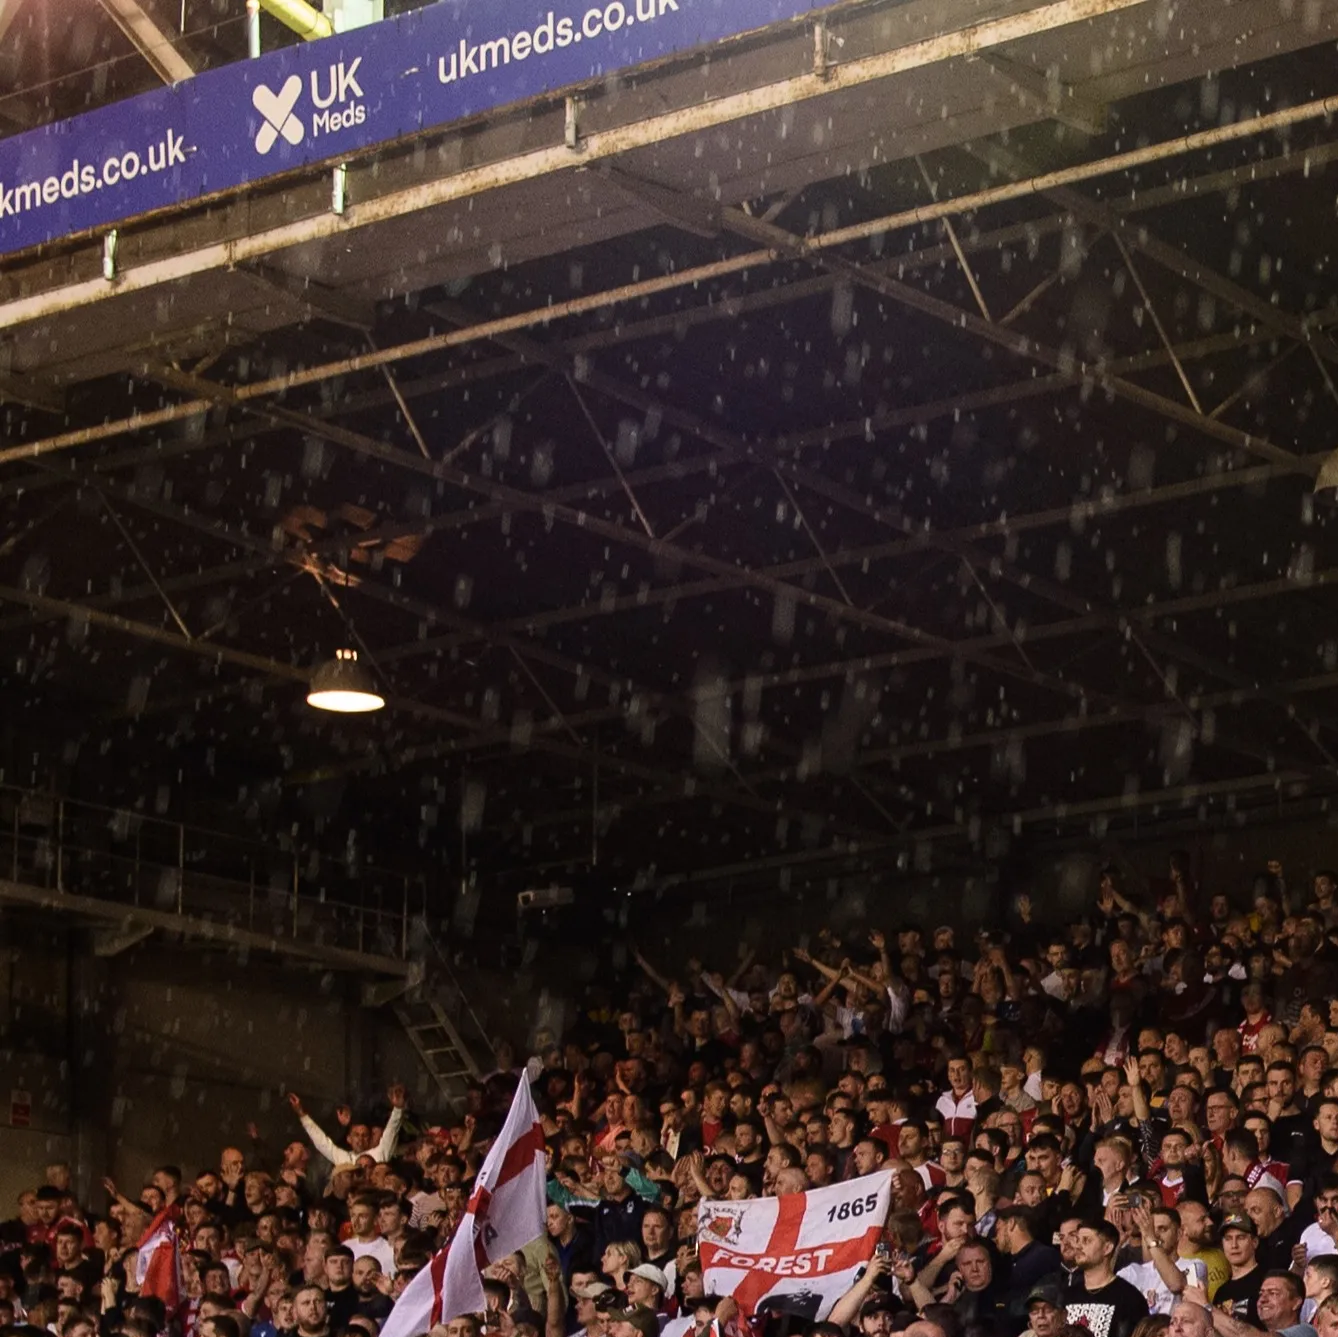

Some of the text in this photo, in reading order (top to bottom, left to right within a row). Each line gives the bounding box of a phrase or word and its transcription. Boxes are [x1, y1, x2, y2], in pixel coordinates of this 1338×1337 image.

[310, 57, 364, 108] UK
[312, 100, 366, 138] Meds
[826, 1192, 879, 1224] 1865
[710, 1248, 834, 1275] FOREST
